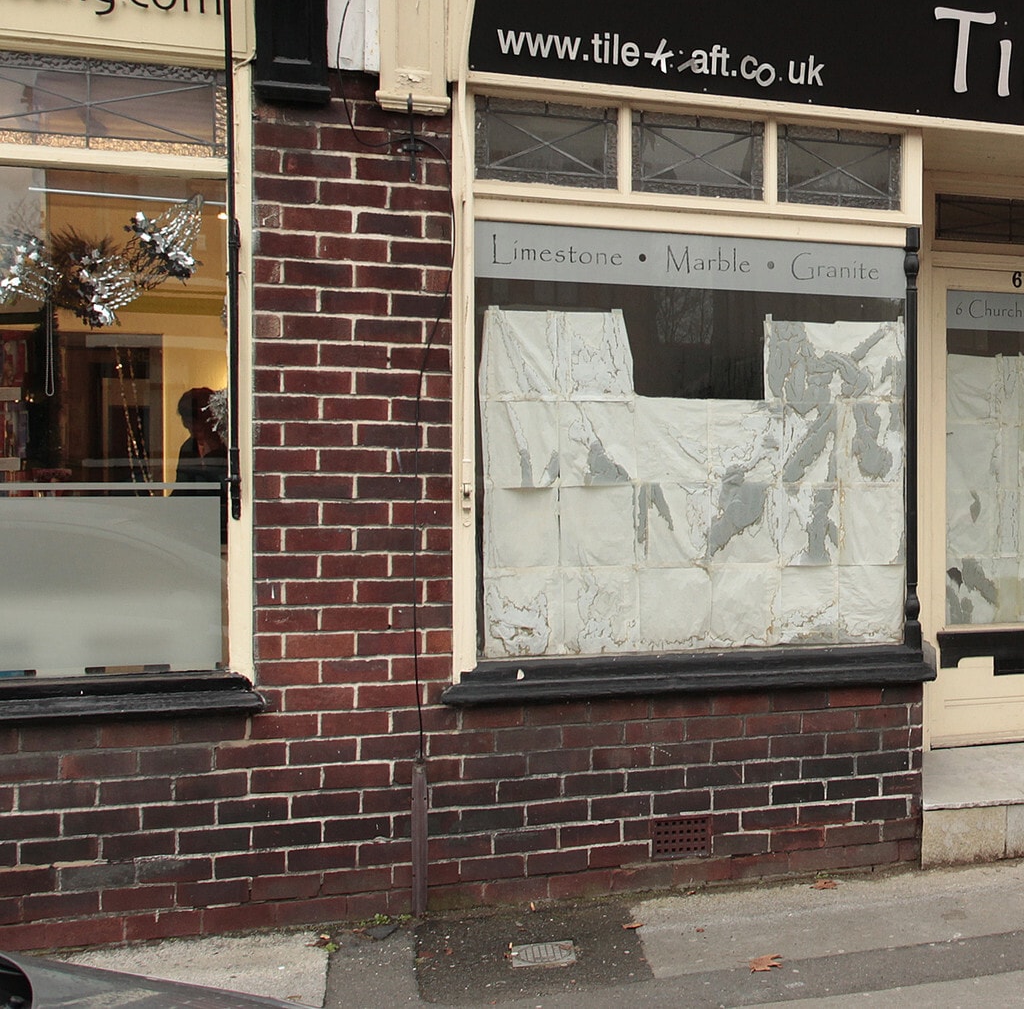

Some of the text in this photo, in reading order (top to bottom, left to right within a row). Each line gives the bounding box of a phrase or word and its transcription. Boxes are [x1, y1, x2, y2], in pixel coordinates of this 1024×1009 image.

[492, 233, 881, 282] Limestone Marble Granite
[1012, 271, 1023, 288] 6
[955, 301, 964, 316] 6
[968, 299, 1023, 320] Church
